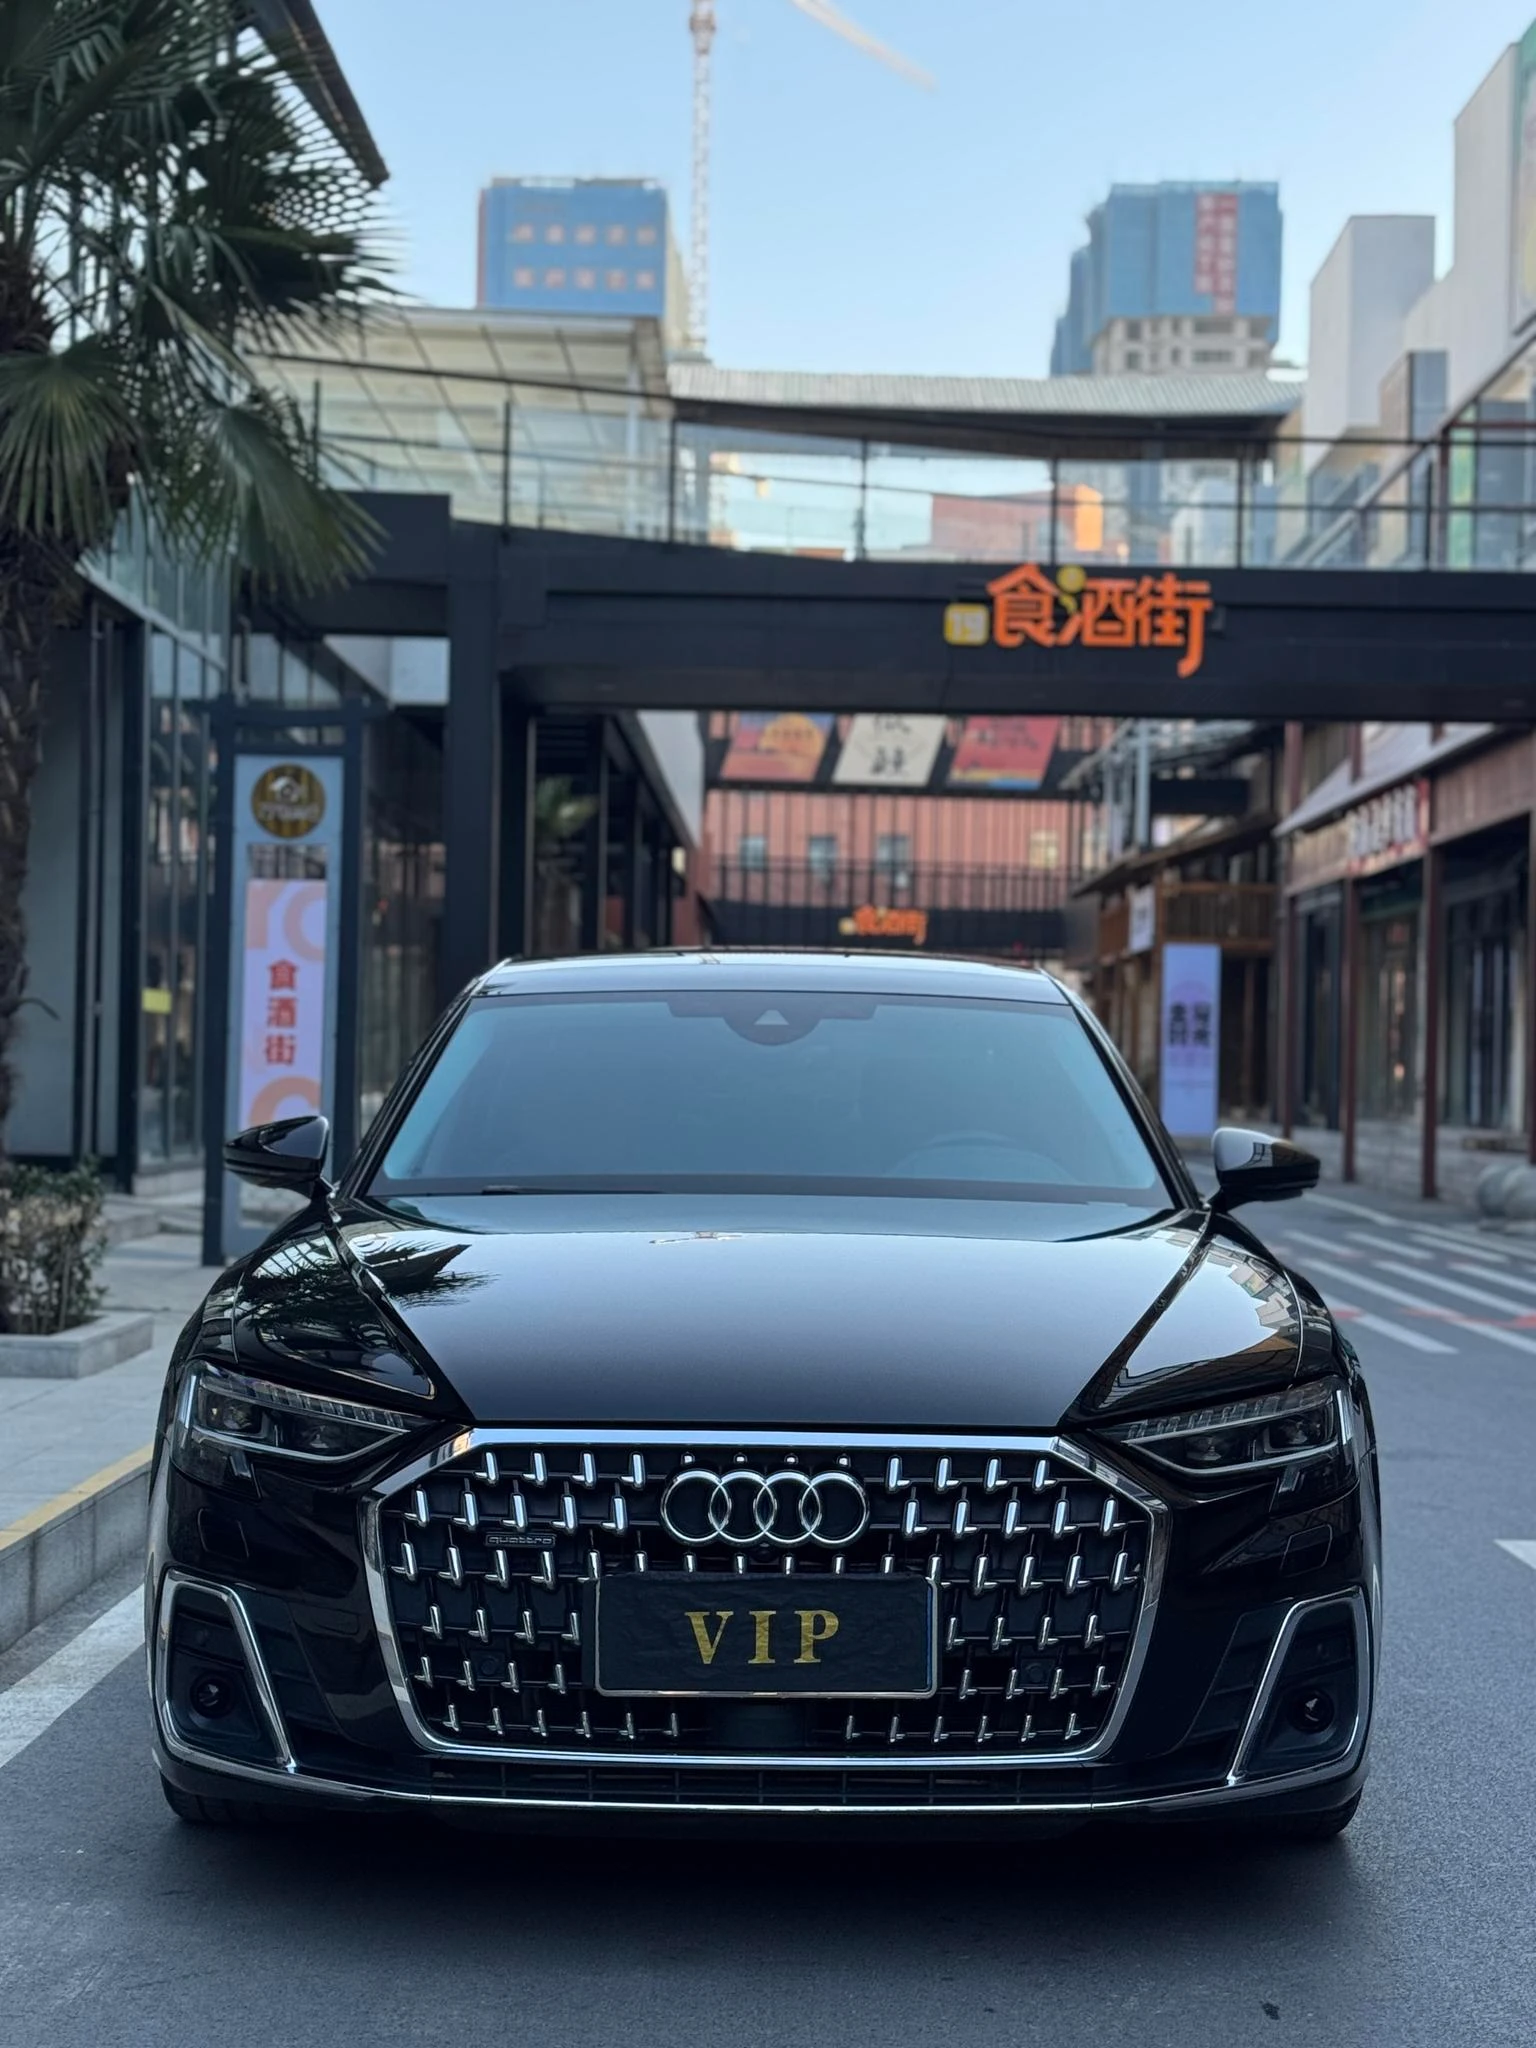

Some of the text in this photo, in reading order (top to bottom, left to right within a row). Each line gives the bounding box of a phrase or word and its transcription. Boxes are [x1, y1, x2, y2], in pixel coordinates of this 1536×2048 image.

[986, 563, 1213, 678] 食酒街
[264, 959, 299, 1066] 食酒街
[488, 1535, 553, 1545] quattro
[684, 1609, 839, 1664] VIP
